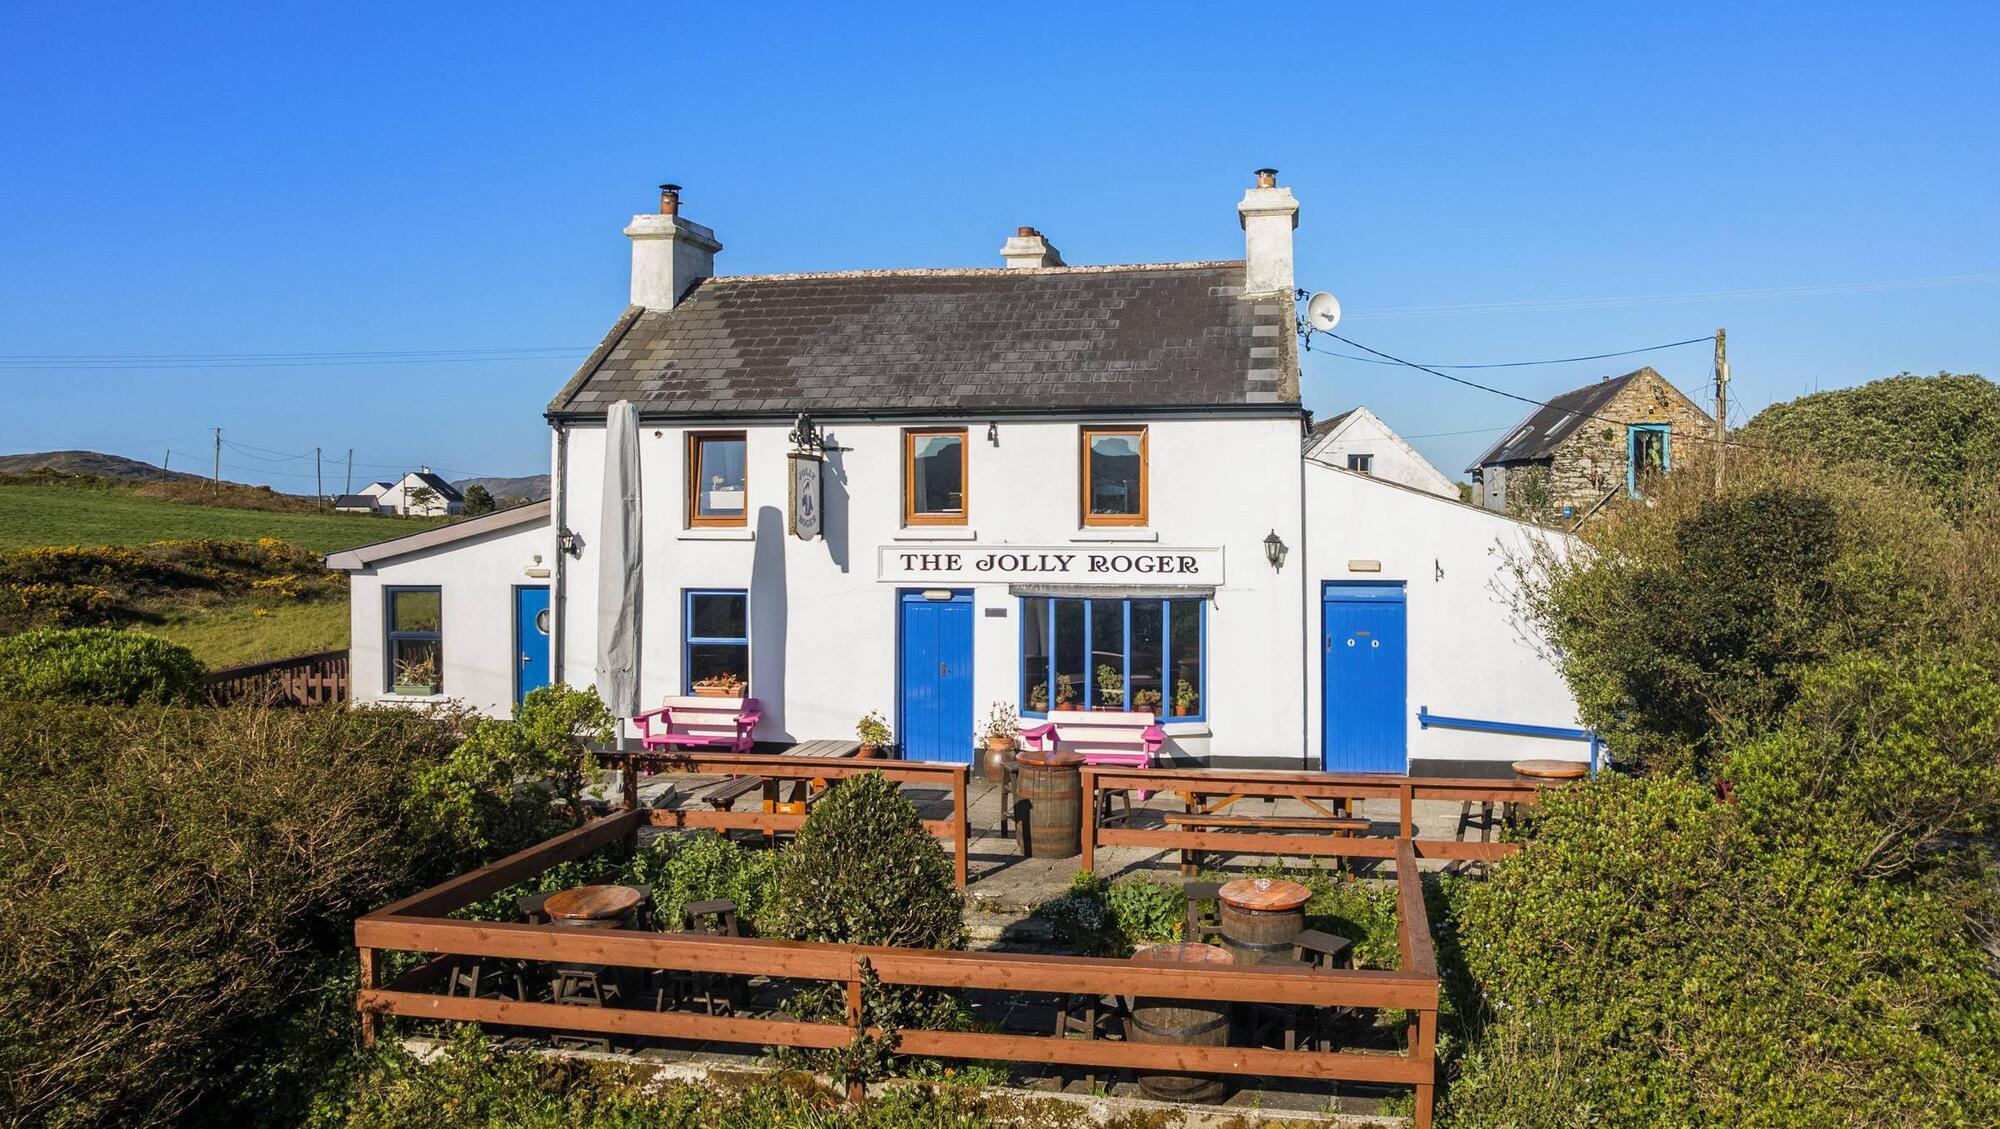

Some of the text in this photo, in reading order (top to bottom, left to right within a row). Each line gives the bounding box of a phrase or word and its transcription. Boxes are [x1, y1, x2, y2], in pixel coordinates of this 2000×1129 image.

[799, 467, 817, 480] JOLLY
[900, 554, 1199, 574] THE JOLLY ROGER
